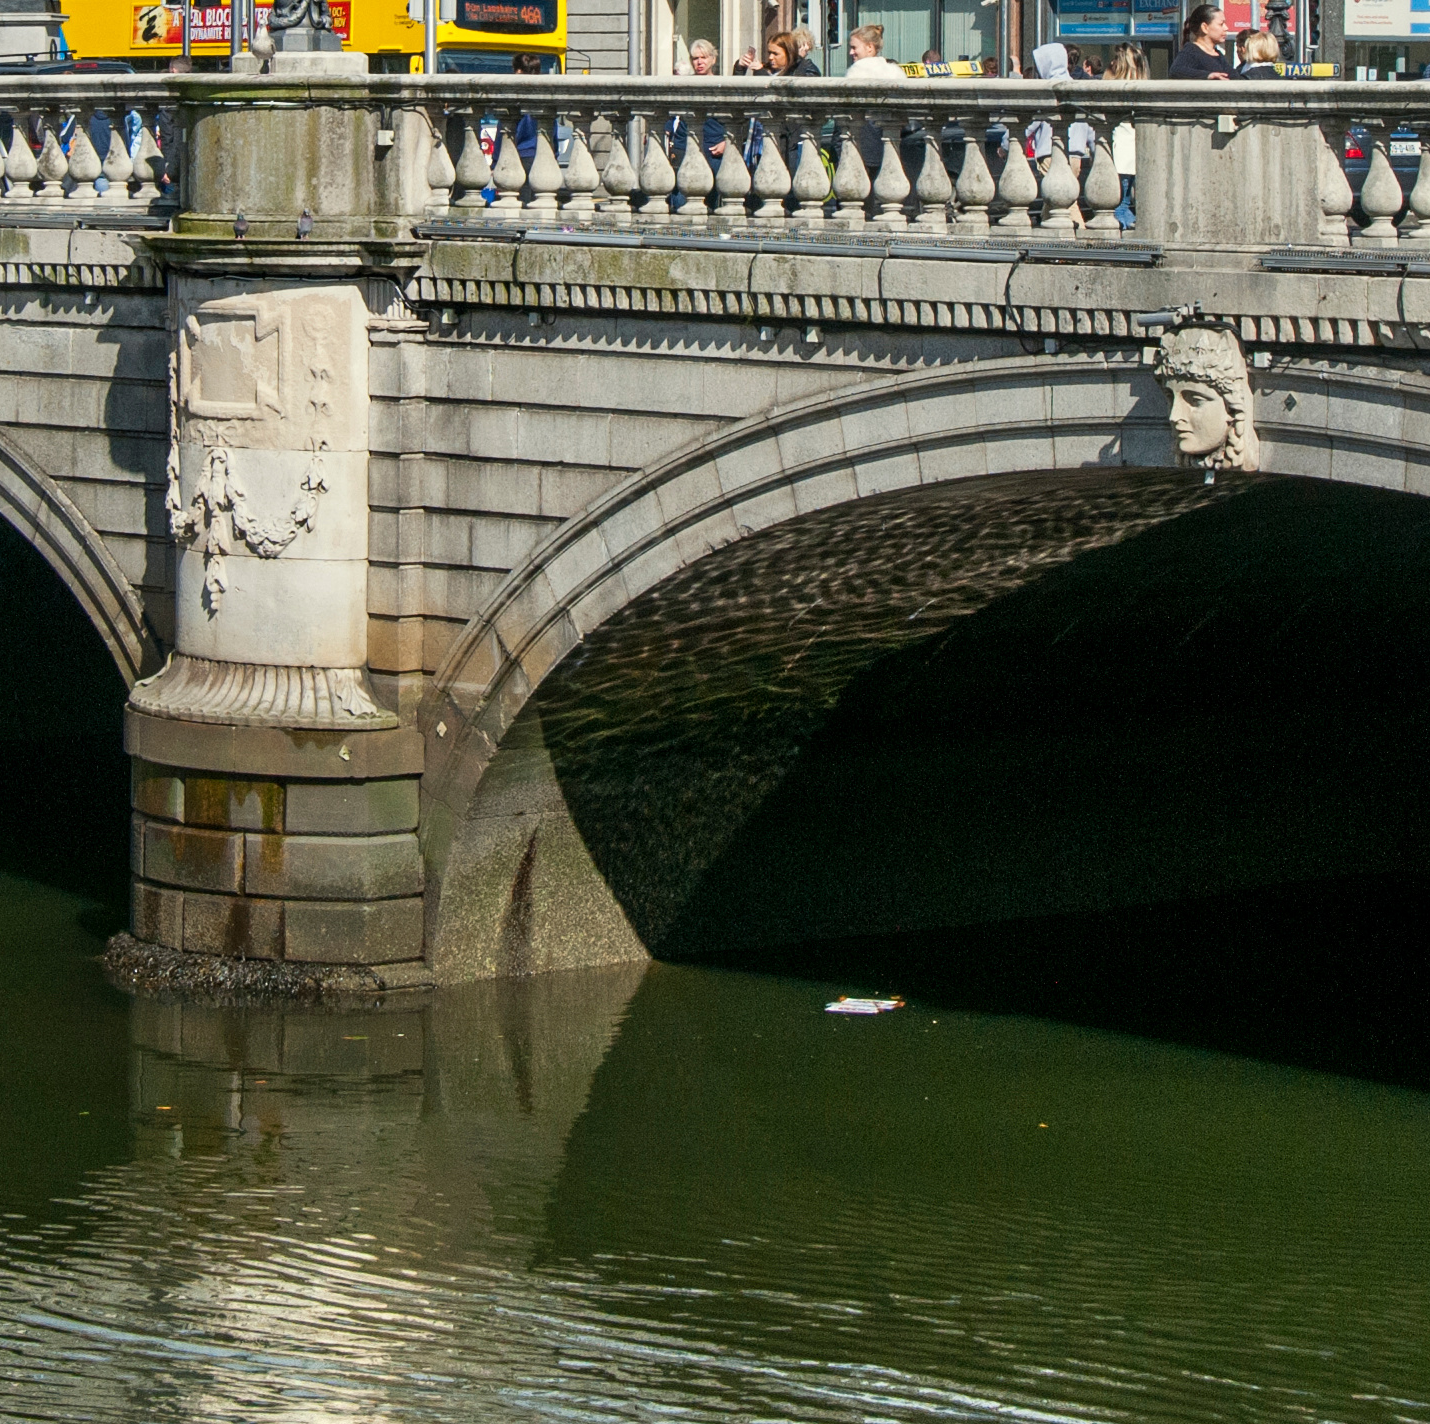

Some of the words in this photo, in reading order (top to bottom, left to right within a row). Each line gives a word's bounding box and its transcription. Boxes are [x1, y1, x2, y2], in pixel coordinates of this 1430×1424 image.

[521, 5, 542, 24] 46A
[926, 63, 952, 75] TAXI
[1286, 64, 1311, 76] TAXI
